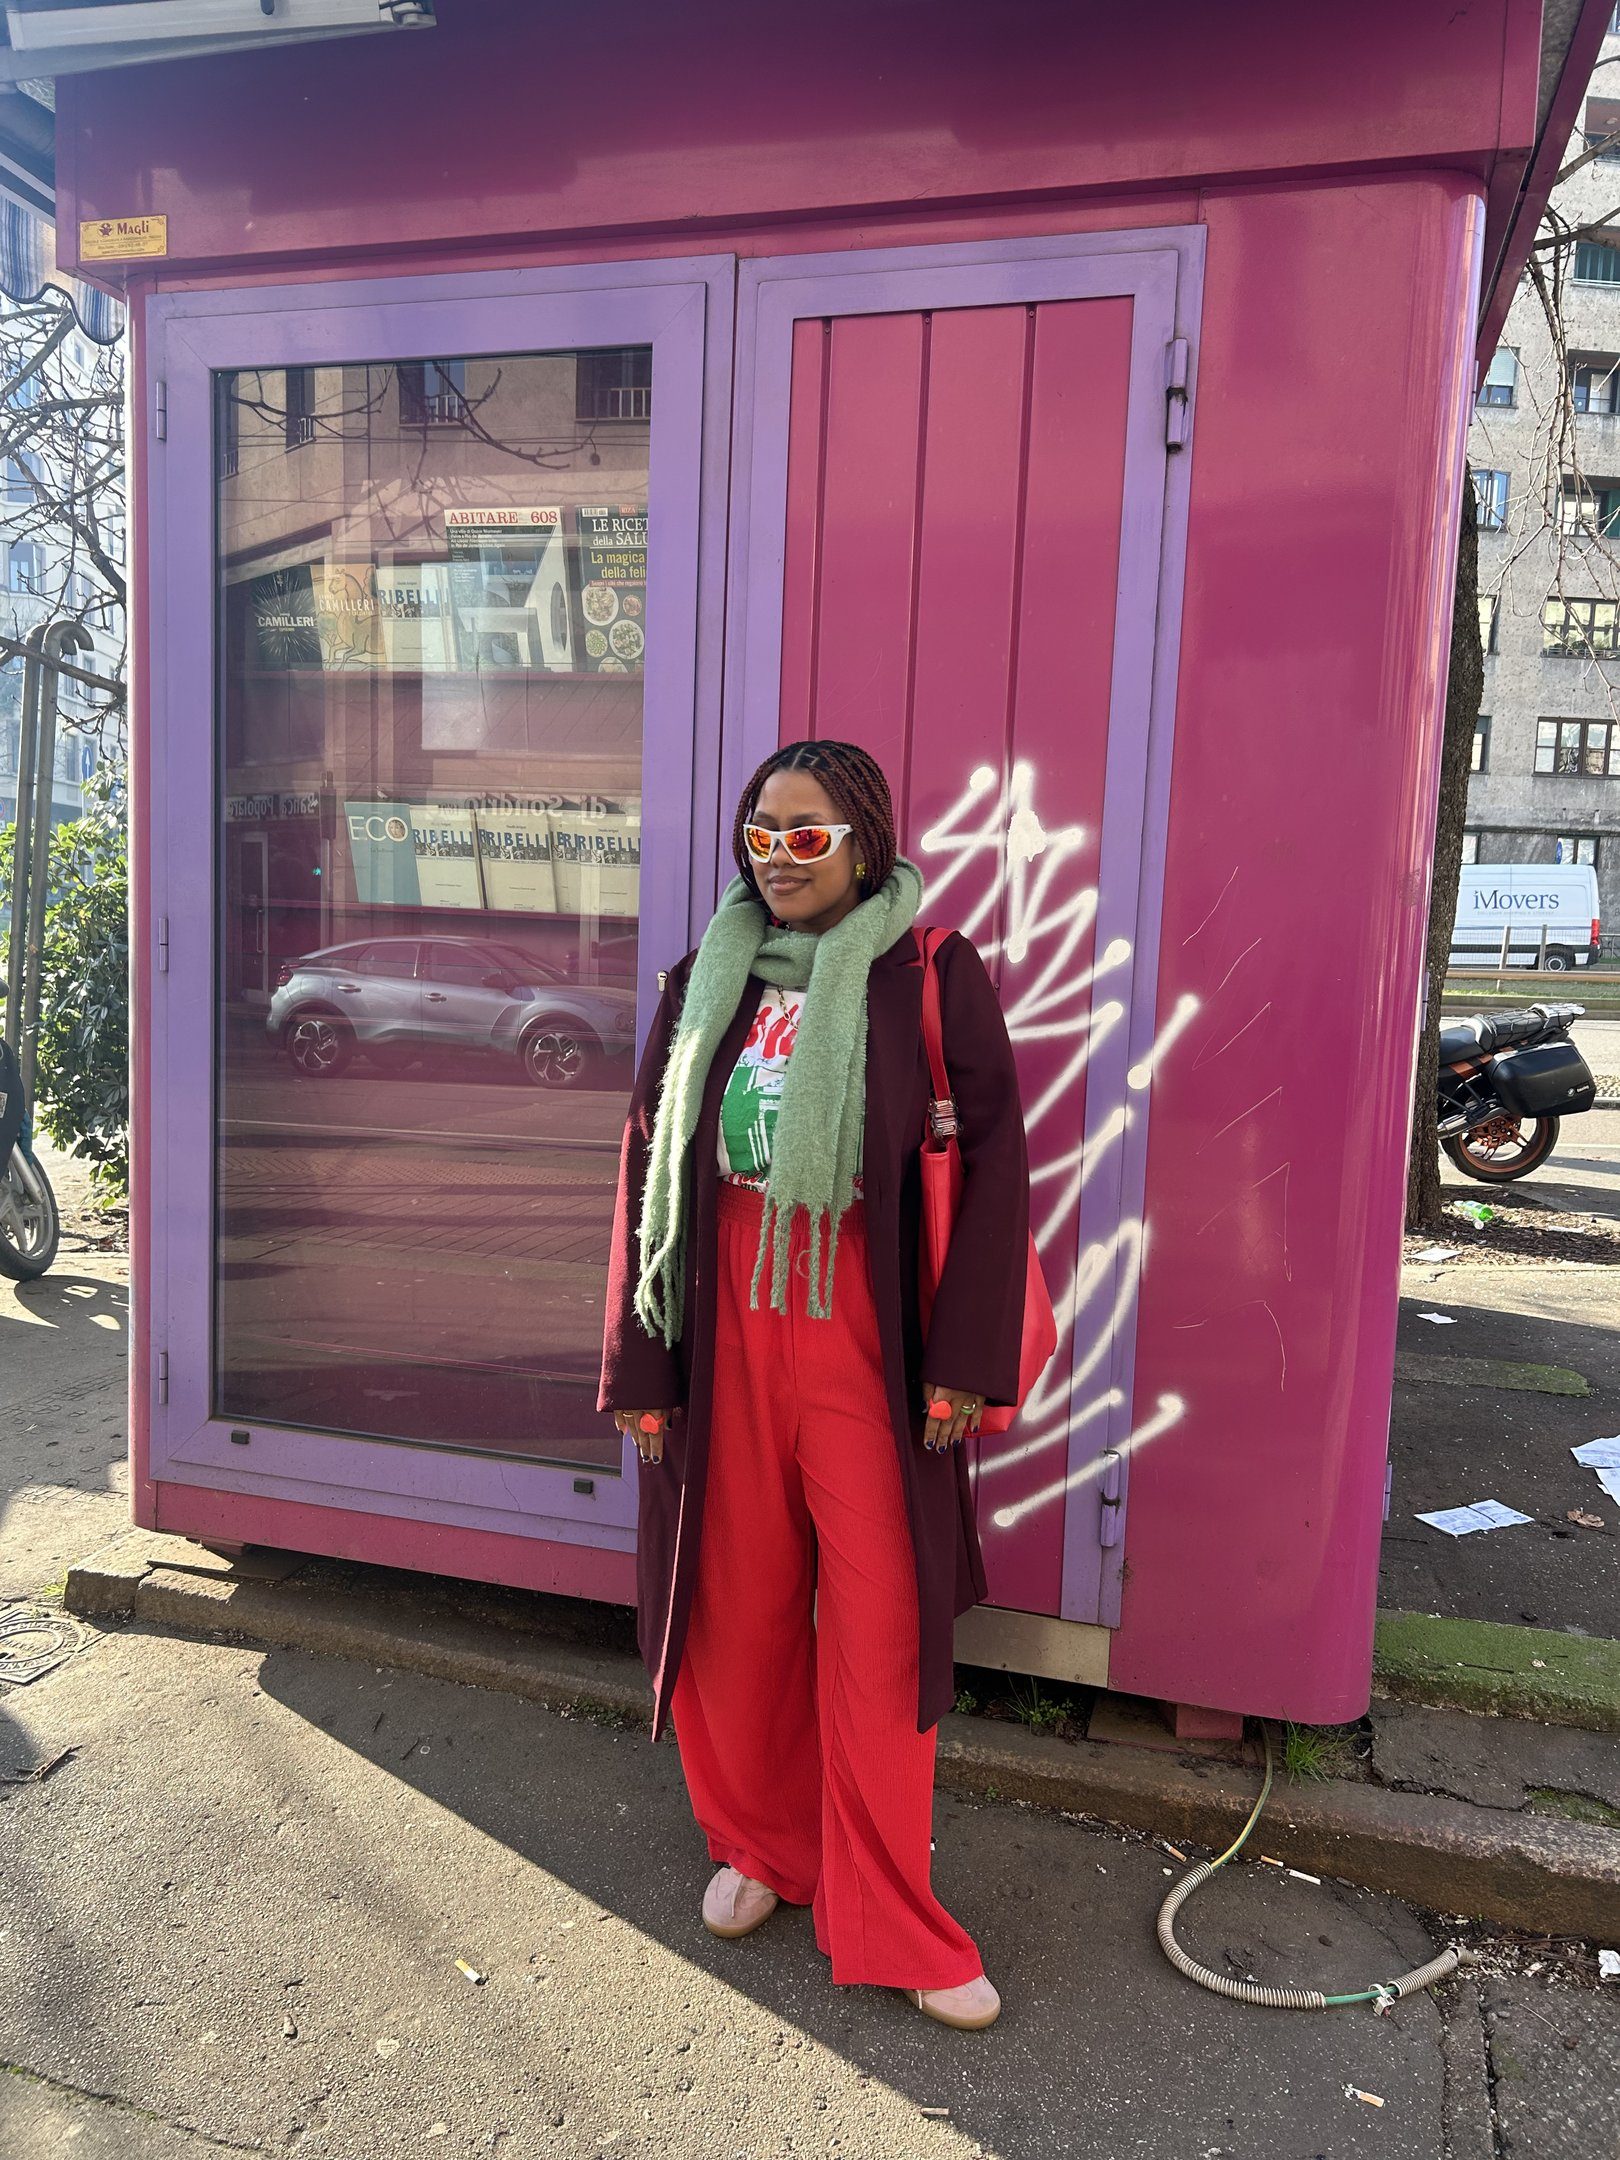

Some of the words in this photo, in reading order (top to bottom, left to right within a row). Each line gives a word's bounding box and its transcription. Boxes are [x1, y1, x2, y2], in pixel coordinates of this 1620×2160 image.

[117, 220, 150, 236] Magli
[449, 511, 519, 525] ABITARE
[531, 511, 558, 523] 608
[592, 519, 609, 532] LE
[593, 535, 613, 546] della
[591, 551, 603, 564] La
[607, 551, 645, 566] magica
[601, 566, 626, 579] della
[319, 598, 374, 612] CAMILLERI
[258, 616, 315, 627] CAMILLERI
[348, 815, 409, 842] ECO
[1473, 889, 1559, 910] iMovers
